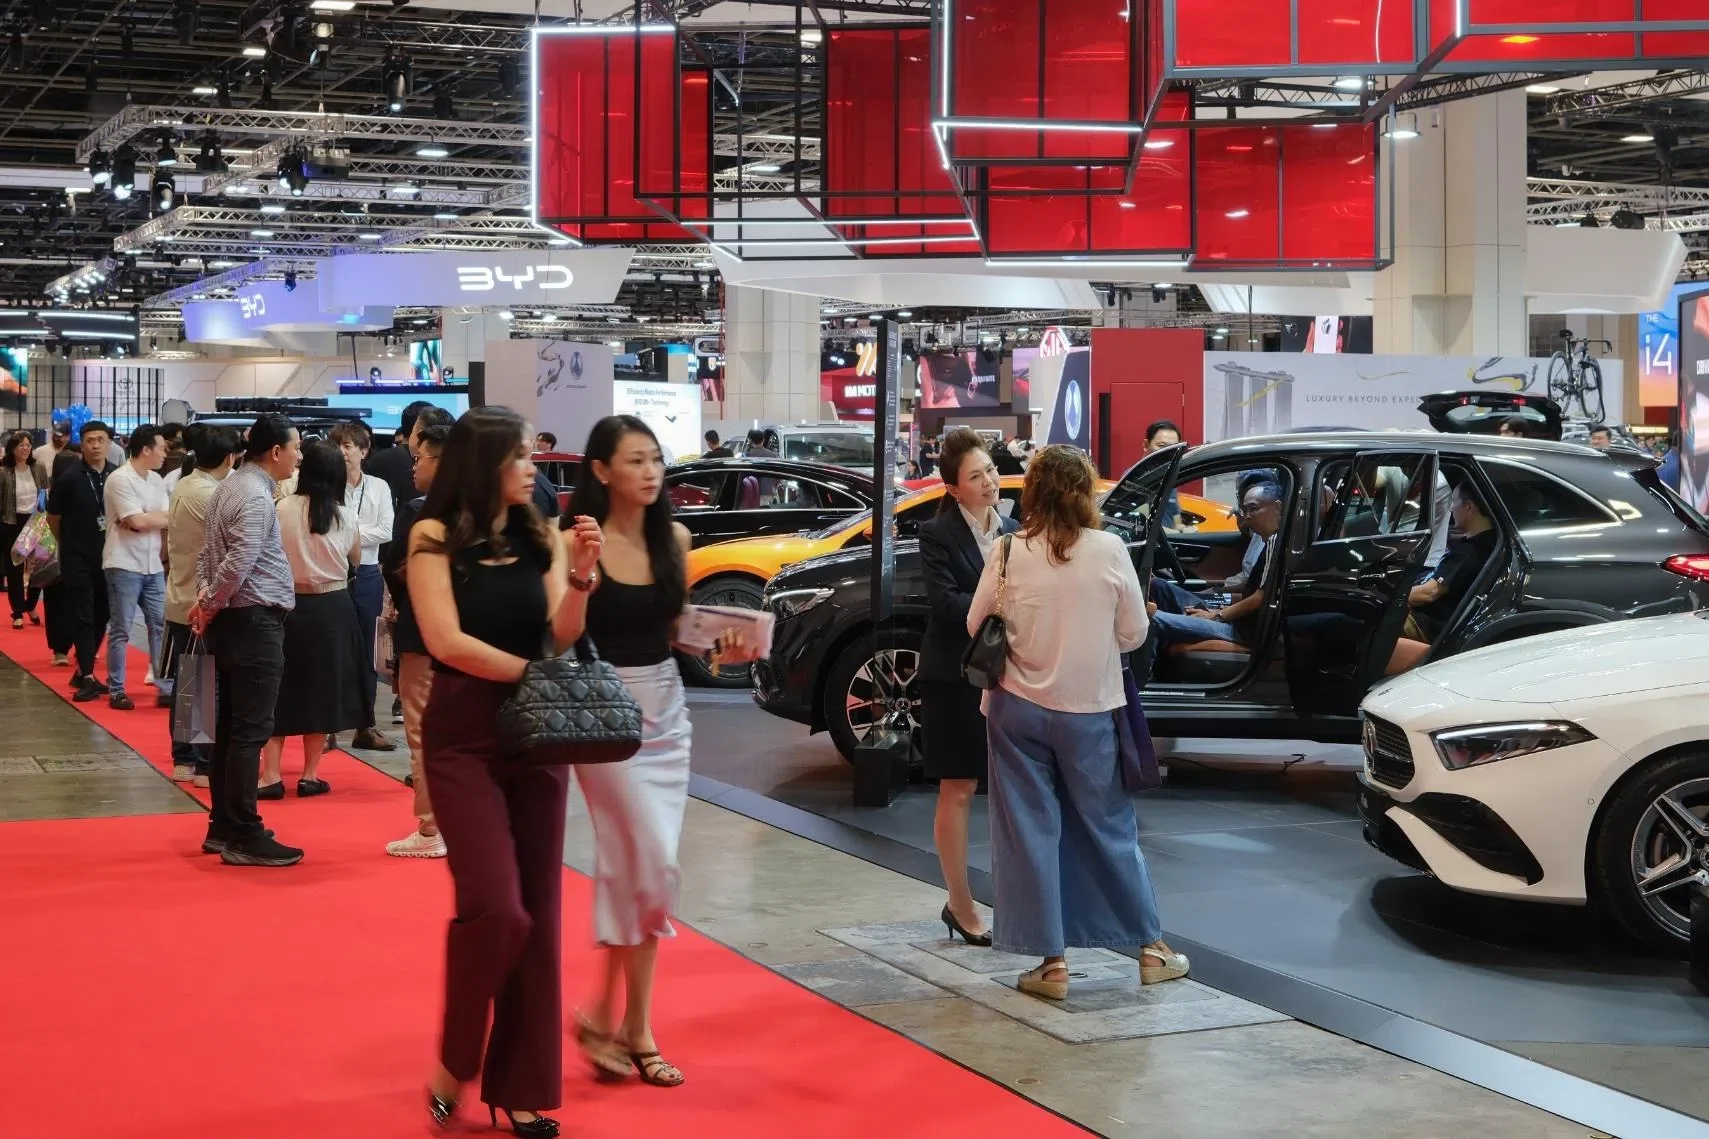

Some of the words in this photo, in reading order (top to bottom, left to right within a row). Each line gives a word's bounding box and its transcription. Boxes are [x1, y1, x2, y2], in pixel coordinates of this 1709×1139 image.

[457, 265, 573, 291] BYD
[240, 294, 265, 319] BYD
[1646, 314, 1660, 323] THE
[1645, 333, 1672, 375] i4
[857, 384, 877, 397] MOT
[1349, 395, 1388, 403] BEYOND
[1392, 396, 1421, 404] EXPEC
